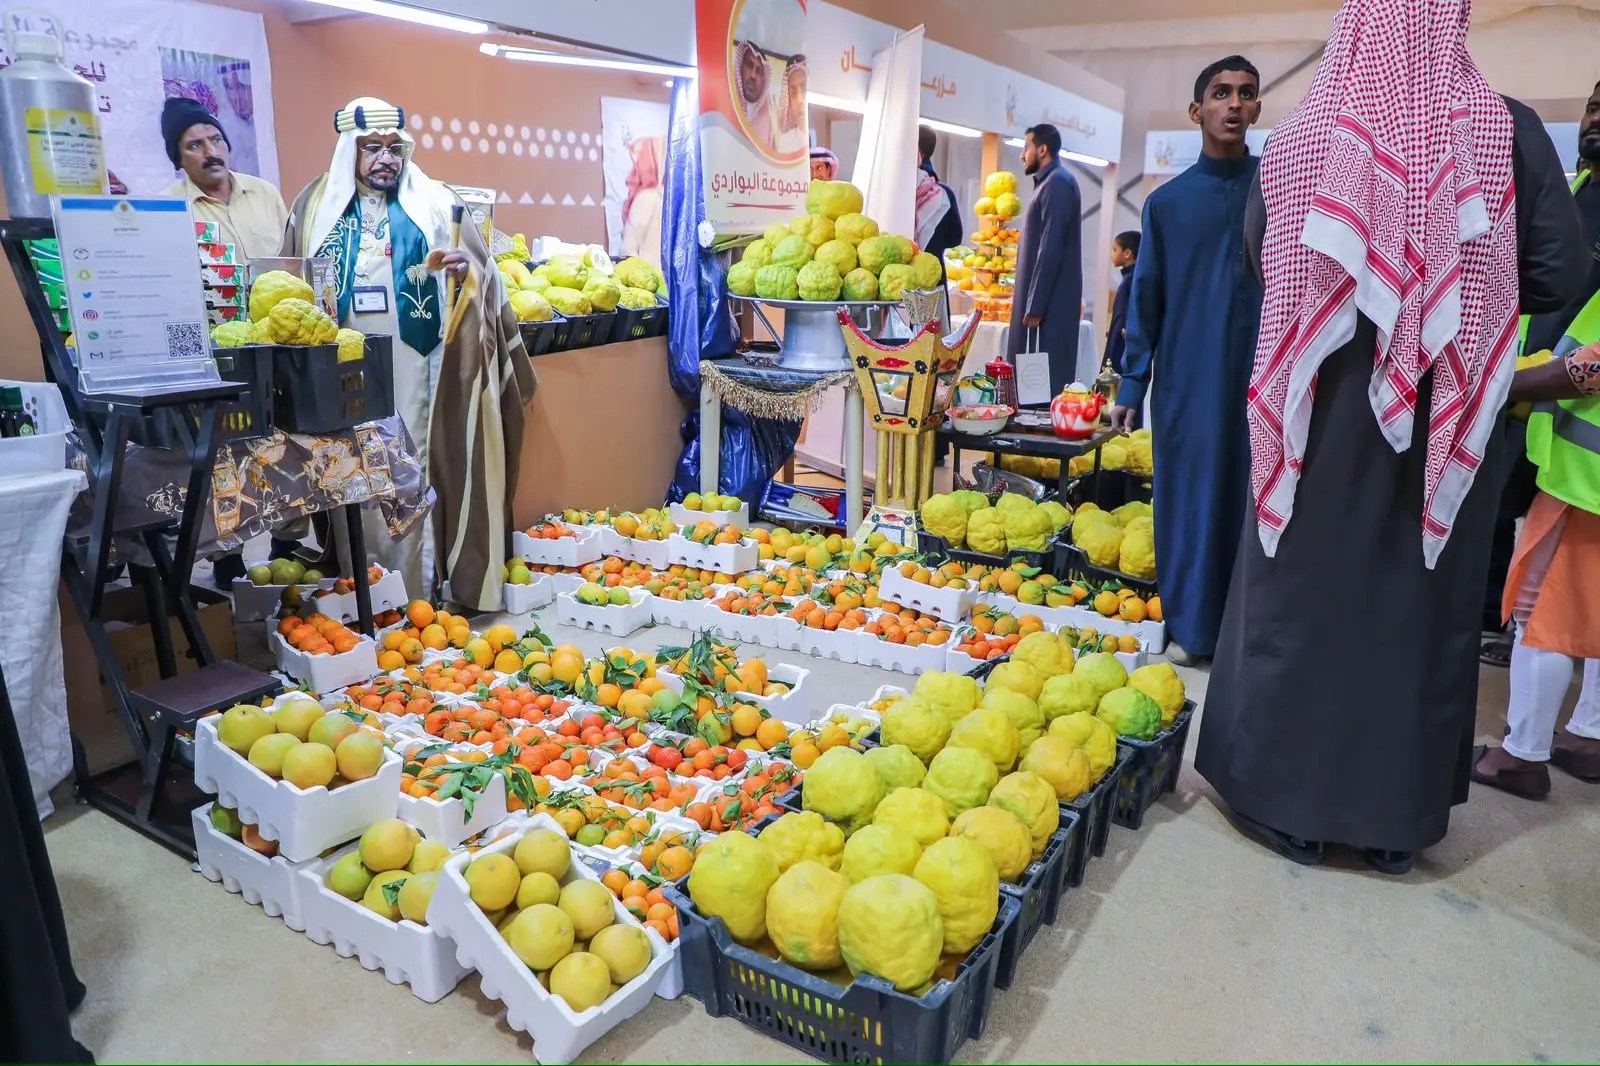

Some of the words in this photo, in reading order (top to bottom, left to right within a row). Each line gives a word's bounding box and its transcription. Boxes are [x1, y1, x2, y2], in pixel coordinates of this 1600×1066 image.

[920, 74, 957, 99] مزرع
[711, 170, 760, 199] البواردي
[761, 171, 810, 199] مجموعة
